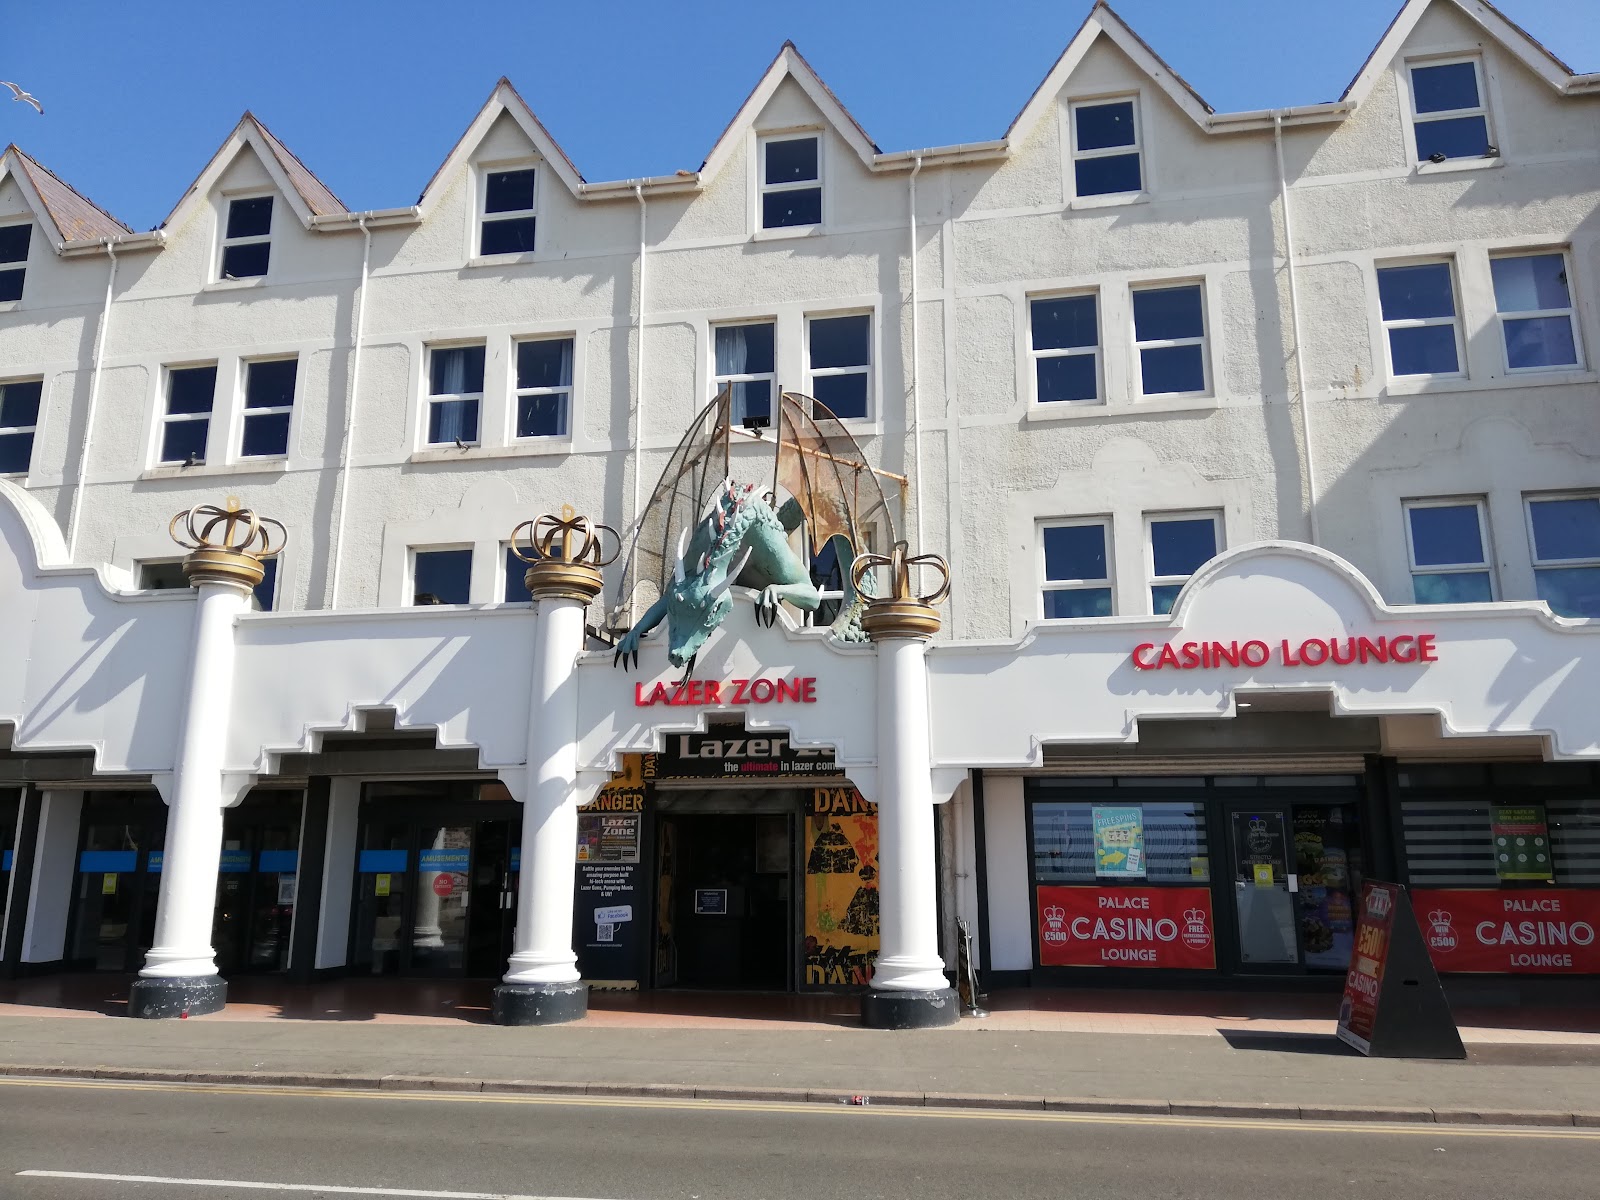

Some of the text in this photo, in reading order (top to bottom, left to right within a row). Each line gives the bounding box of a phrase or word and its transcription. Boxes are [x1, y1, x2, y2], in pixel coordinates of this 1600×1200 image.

[1132, 634, 1438, 670] CASINO LOUNGE
[635, 677, 817, 706] LAZER ZONE
[679, 735, 788, 759] Lazer
[724, 760, 837, 772] the ultimate in lazer com
[601, 817, 638, 827] Lazer
[603, 827, 635, 836] Zone
[421, 854, 469, 862] AMUSEMENTS
[1098, 896, 1150, 909] PALACE
[1503, 899, 1561, 912] PALACE
[1049, 920, 1062, 929] WIN
[1071, 916, 1178, 942] CASINO
[1188, 924, 1204, 933] FREE
[1434, 925, 1449, 933] WIN
[1045, 931, 1067, 941] £500
[1476, 921, 1595, 946] CASINO
[1357, 923, 1386, 959] £500
[1430, 937, 1455, 947] £500
[1101, 948, 1157, 962] LOUNGE
[1510, 953, 1573, 967] LOUNGE
[1348, 971, 1378, 998] CASINO
